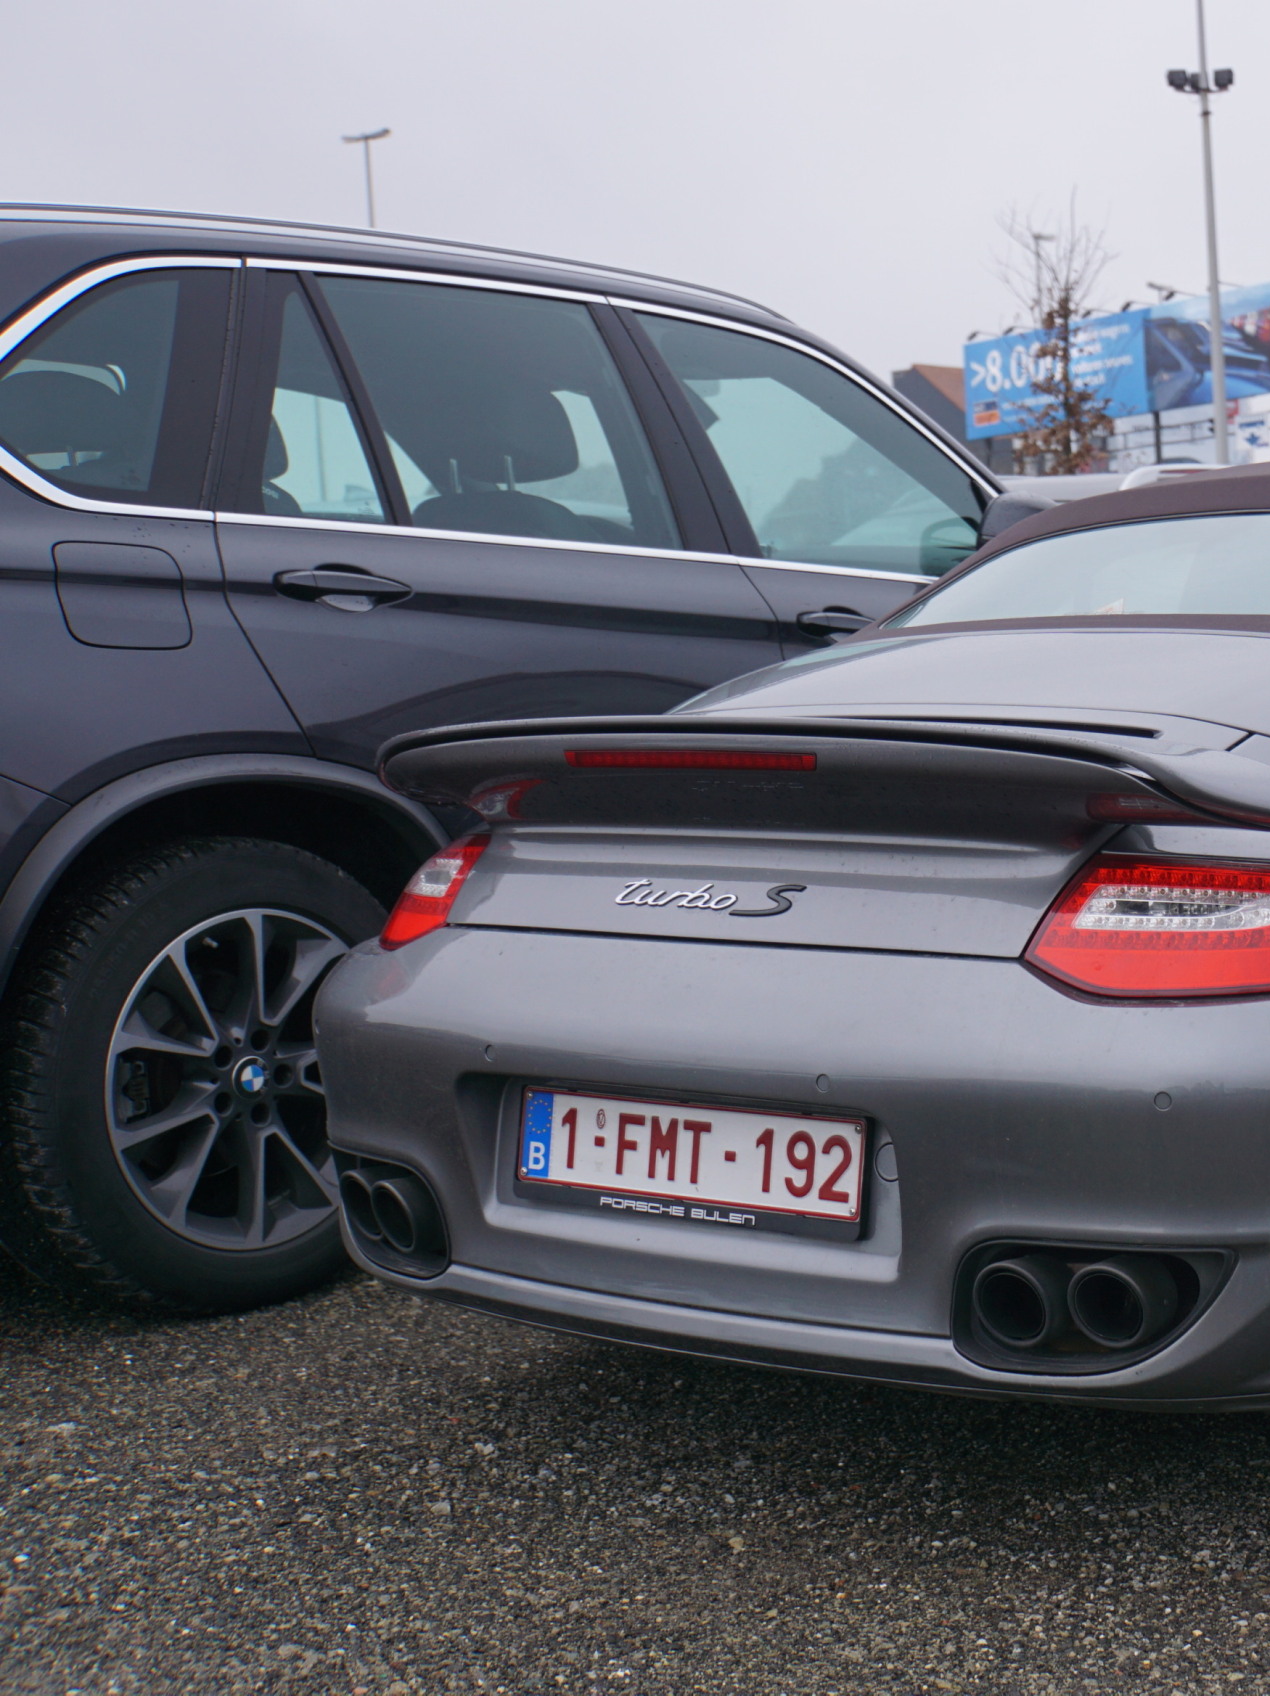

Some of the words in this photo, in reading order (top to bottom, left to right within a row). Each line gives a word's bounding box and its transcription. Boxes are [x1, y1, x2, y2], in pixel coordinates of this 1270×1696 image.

[615, 879, 738, 910] turbo
[729, 884, 807, 917] S
[528, 1141, 546, 1170] B
[561, 1107, 852, 1203] 1-FMT-192
[600, 1196, 685, 1217] PORSCHE
[691, 1208, 756, 1226] BULEN
